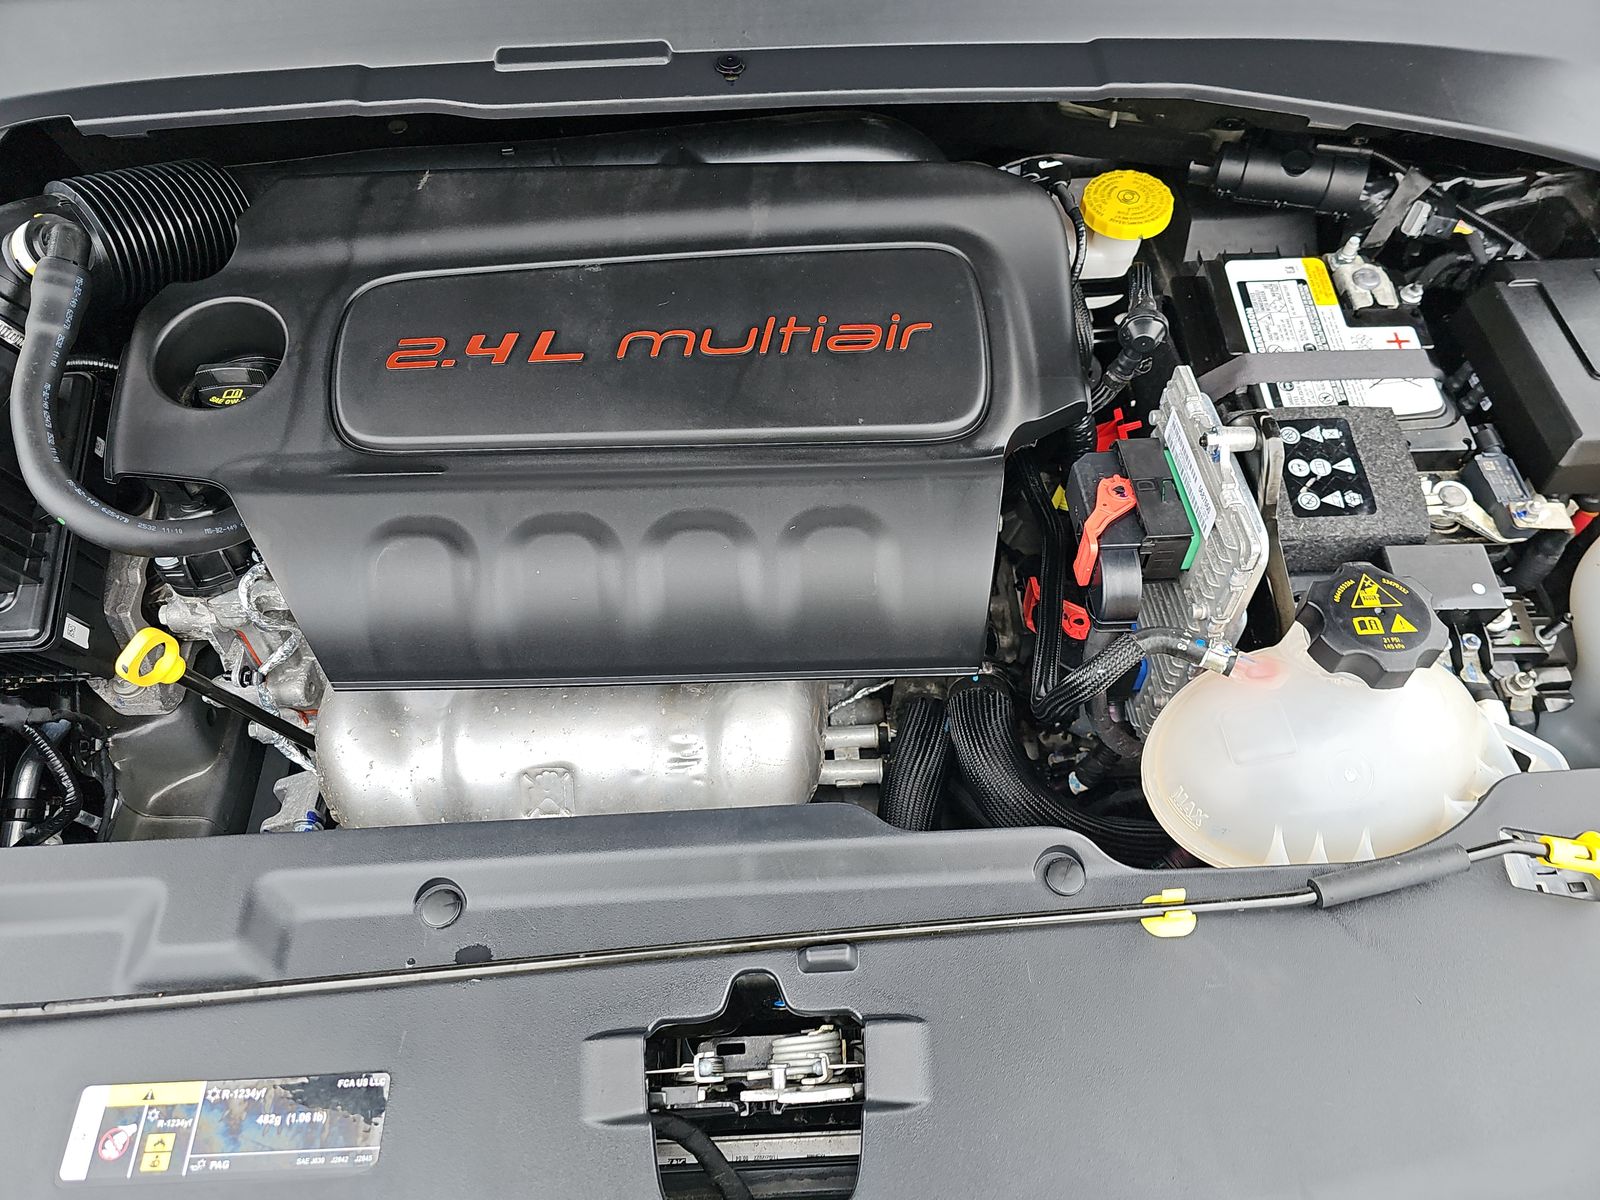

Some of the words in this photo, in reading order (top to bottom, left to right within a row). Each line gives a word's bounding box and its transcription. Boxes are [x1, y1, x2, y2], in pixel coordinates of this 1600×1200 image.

[616, 313, 933, 360] multiair
[137, 522, 157, 531] 2532
[1170, 785, 1209, 827] MAX
[337, 1079, 355, 1088] FCA
[356, 1078, 368, 1088] US
[369, 1077, 386, 1087] LLC
[221, 1087, 267, 1101] R-1234yf
[312, 1111, 327, 1124] lb)
[209, 1160, 230, 1170] PAG
